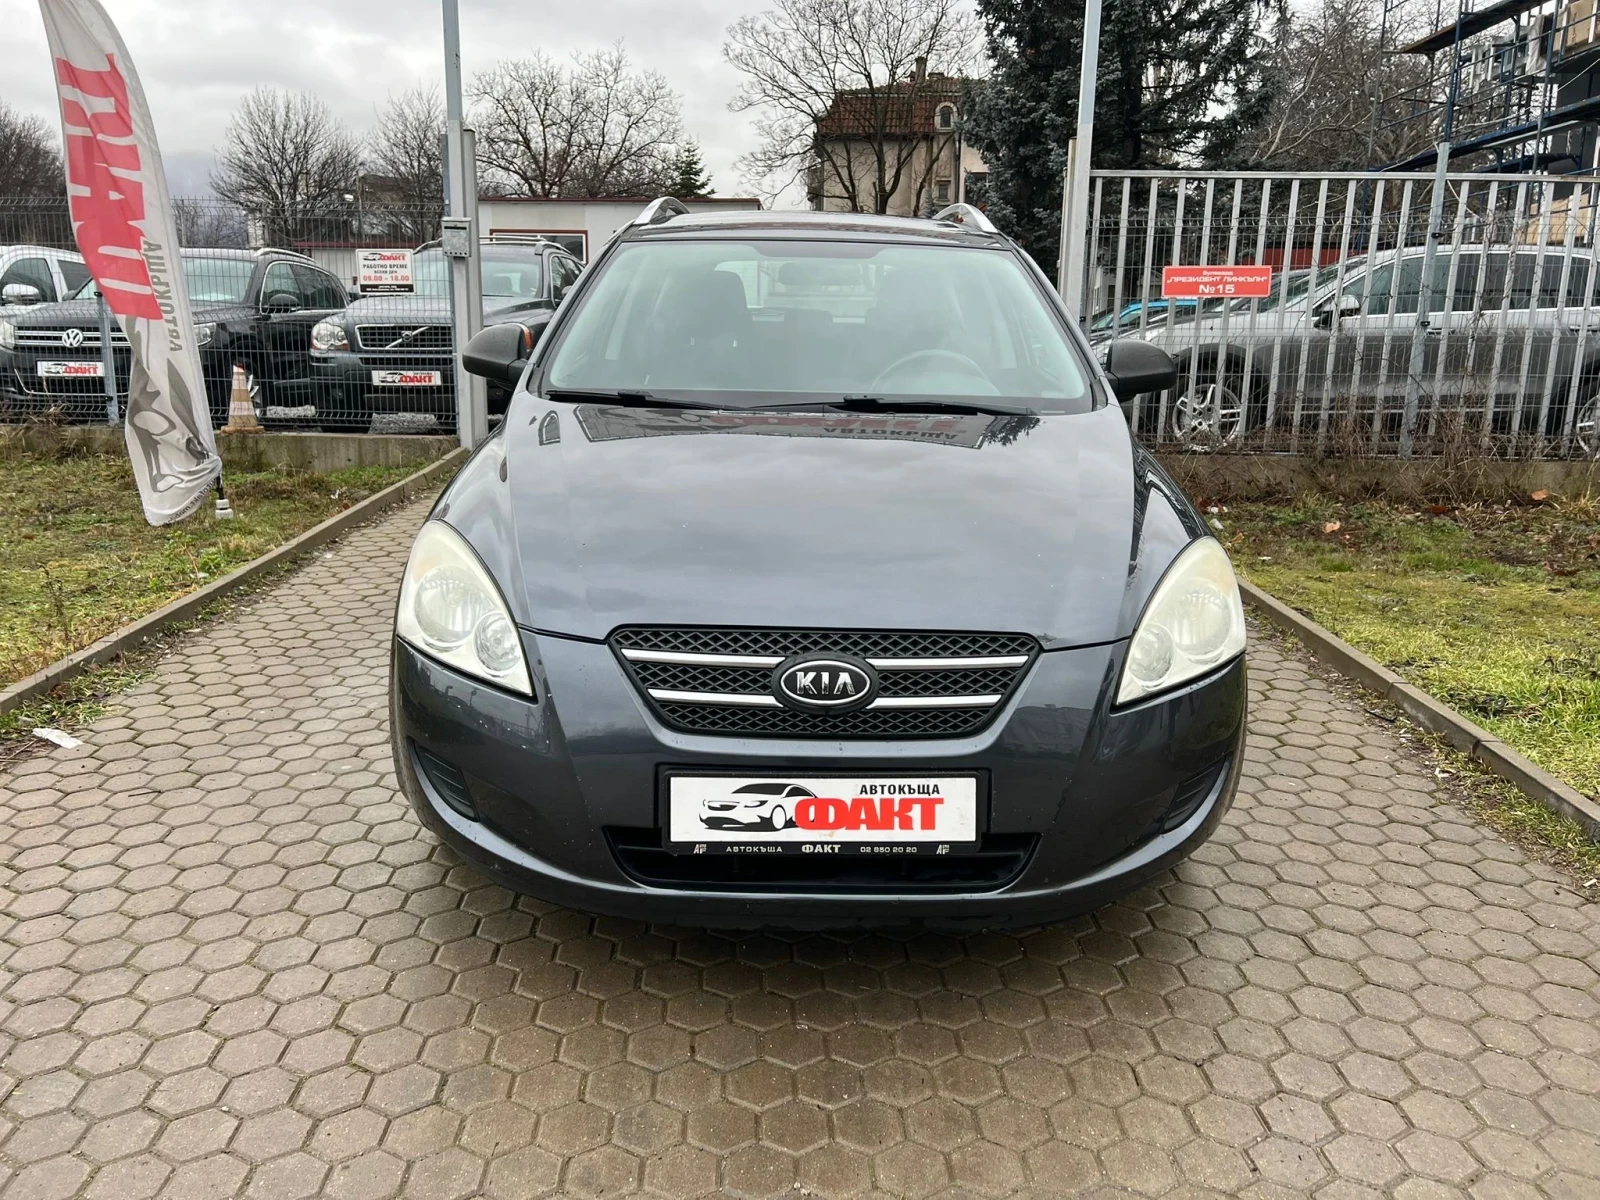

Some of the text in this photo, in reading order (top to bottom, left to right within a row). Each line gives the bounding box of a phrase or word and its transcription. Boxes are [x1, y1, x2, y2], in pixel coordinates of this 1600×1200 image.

[400, 375, 433, 383] ФАКТ
[796, 671, 856, 695] KIA
[859, 784, 940, 796] АВТОКЪЩА
[794, 798, 944, 831] ФАКТ
[801, 844, 841, 853] ФАКТ
